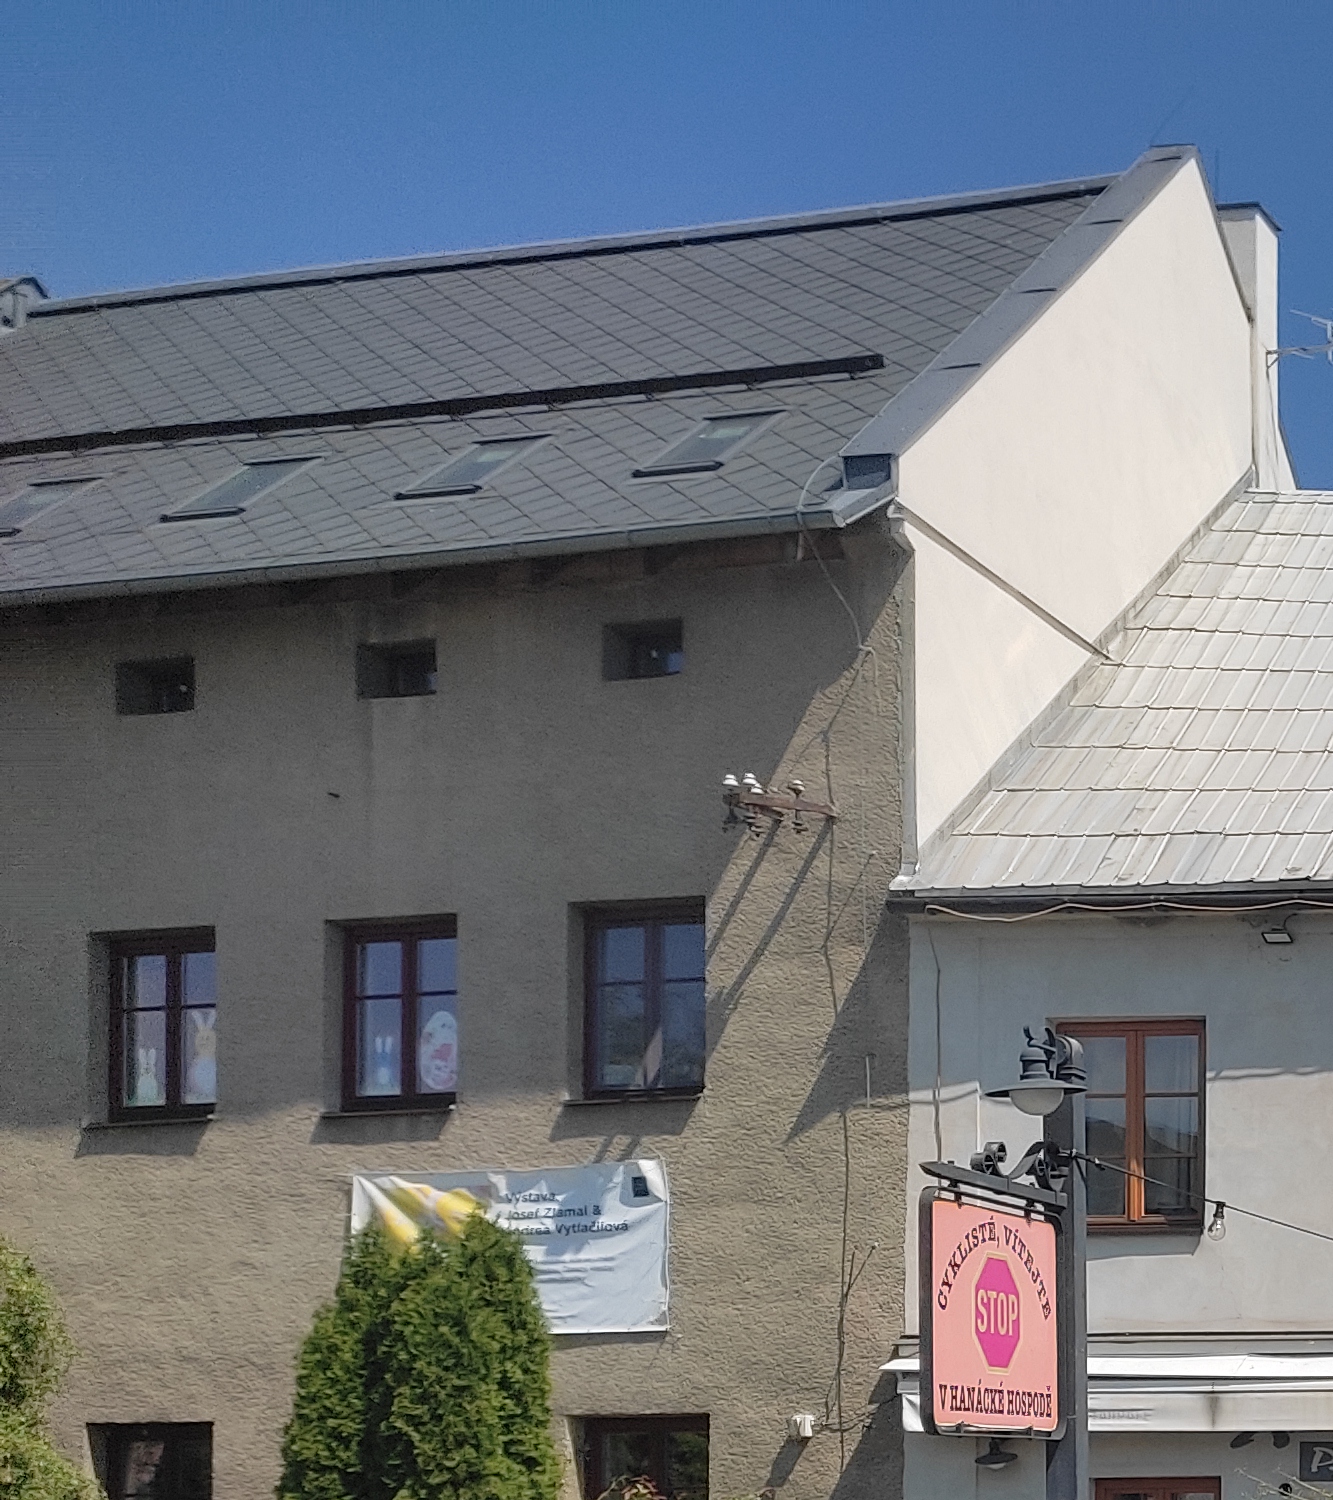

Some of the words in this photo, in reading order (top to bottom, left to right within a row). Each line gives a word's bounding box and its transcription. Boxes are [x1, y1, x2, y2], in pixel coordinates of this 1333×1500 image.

[938, 1215, 1000, 1310] CYKLISTÉ,
[1003, 1224, 1052, 1320] VÍTEJTE
[976, 1288, 1019, 1336] STOP
[939, 1384, 947, 1410] V
[950, 1379, 1004, 1414] HANÁCKÉ
[1007, 1386, 1052, 1418] HOSPODĚ
